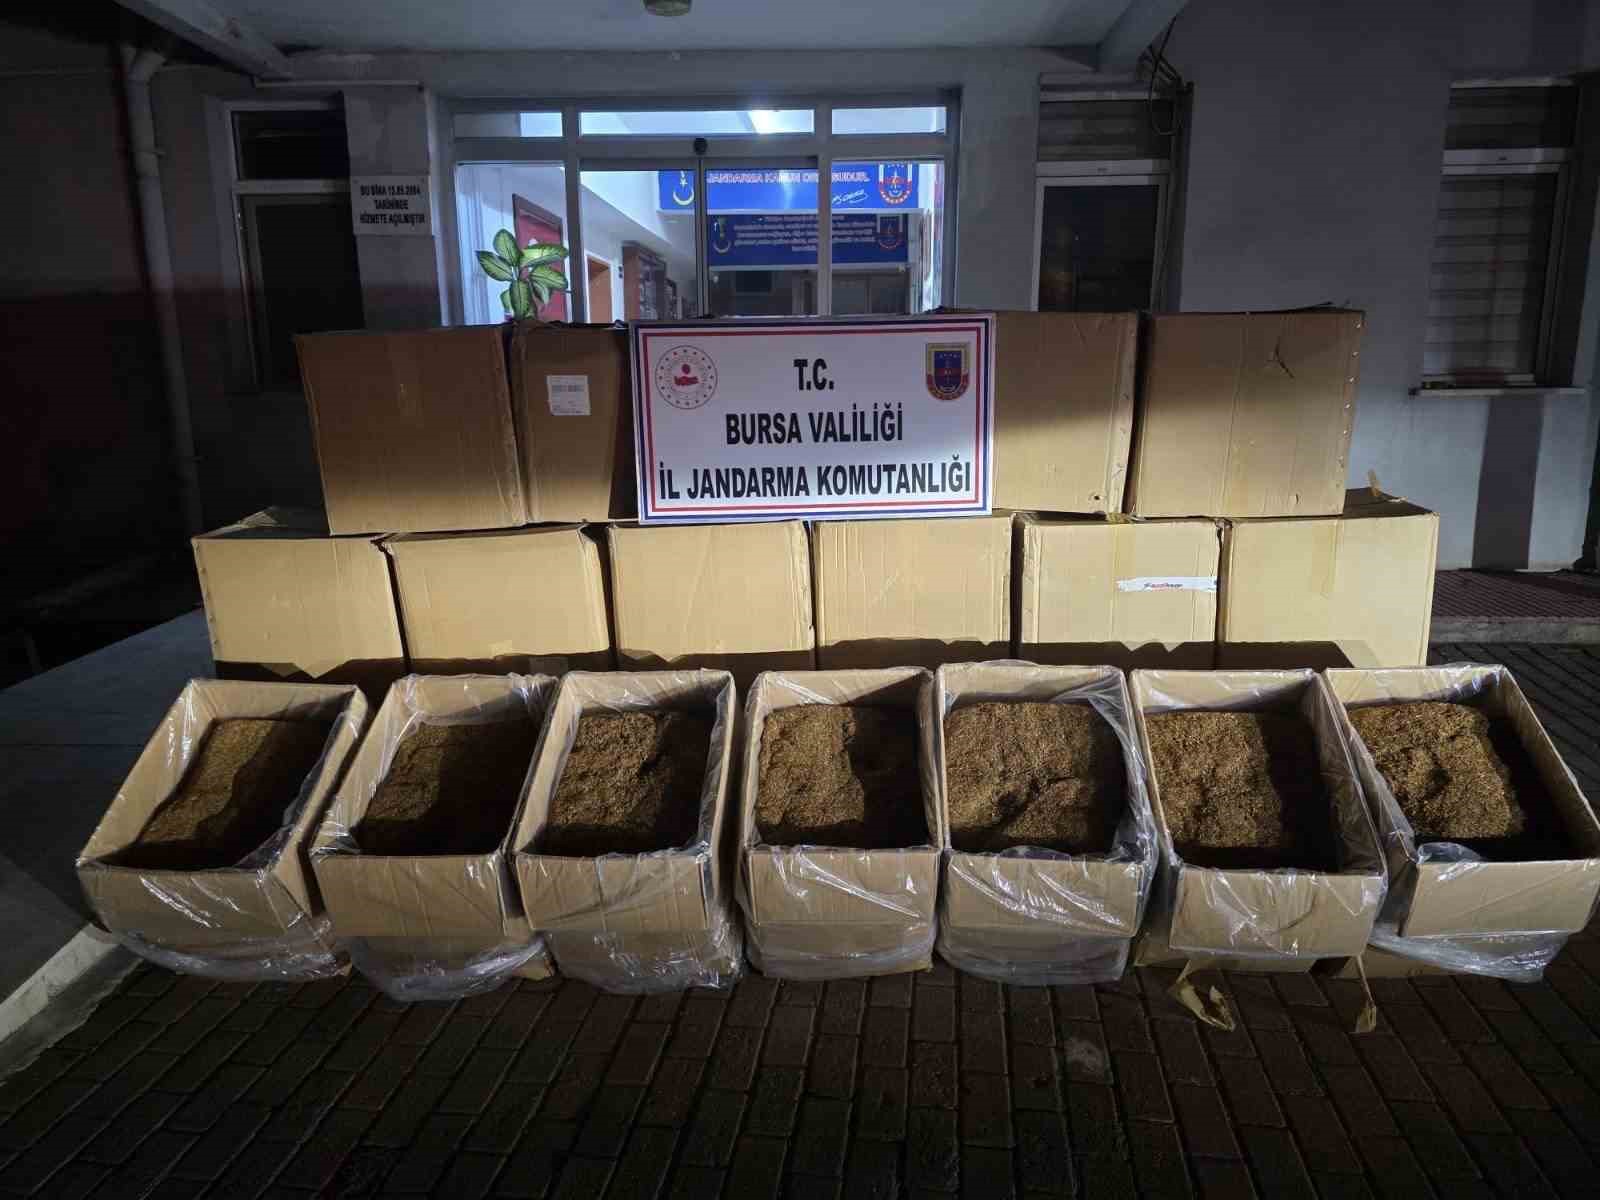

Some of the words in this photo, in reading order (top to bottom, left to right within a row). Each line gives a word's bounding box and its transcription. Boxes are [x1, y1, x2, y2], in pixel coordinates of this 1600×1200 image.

[793, 358, 835, 391] T.C.
[725, 413, 802, 445] BURSA
[808, 402, 903, 443] VALİLİĞİ
[659, 461, 681, 500] İL
[687, 466, 810, 498] JANDARMA
[817, 454, 971, 496] KOMUTANLIĞI
